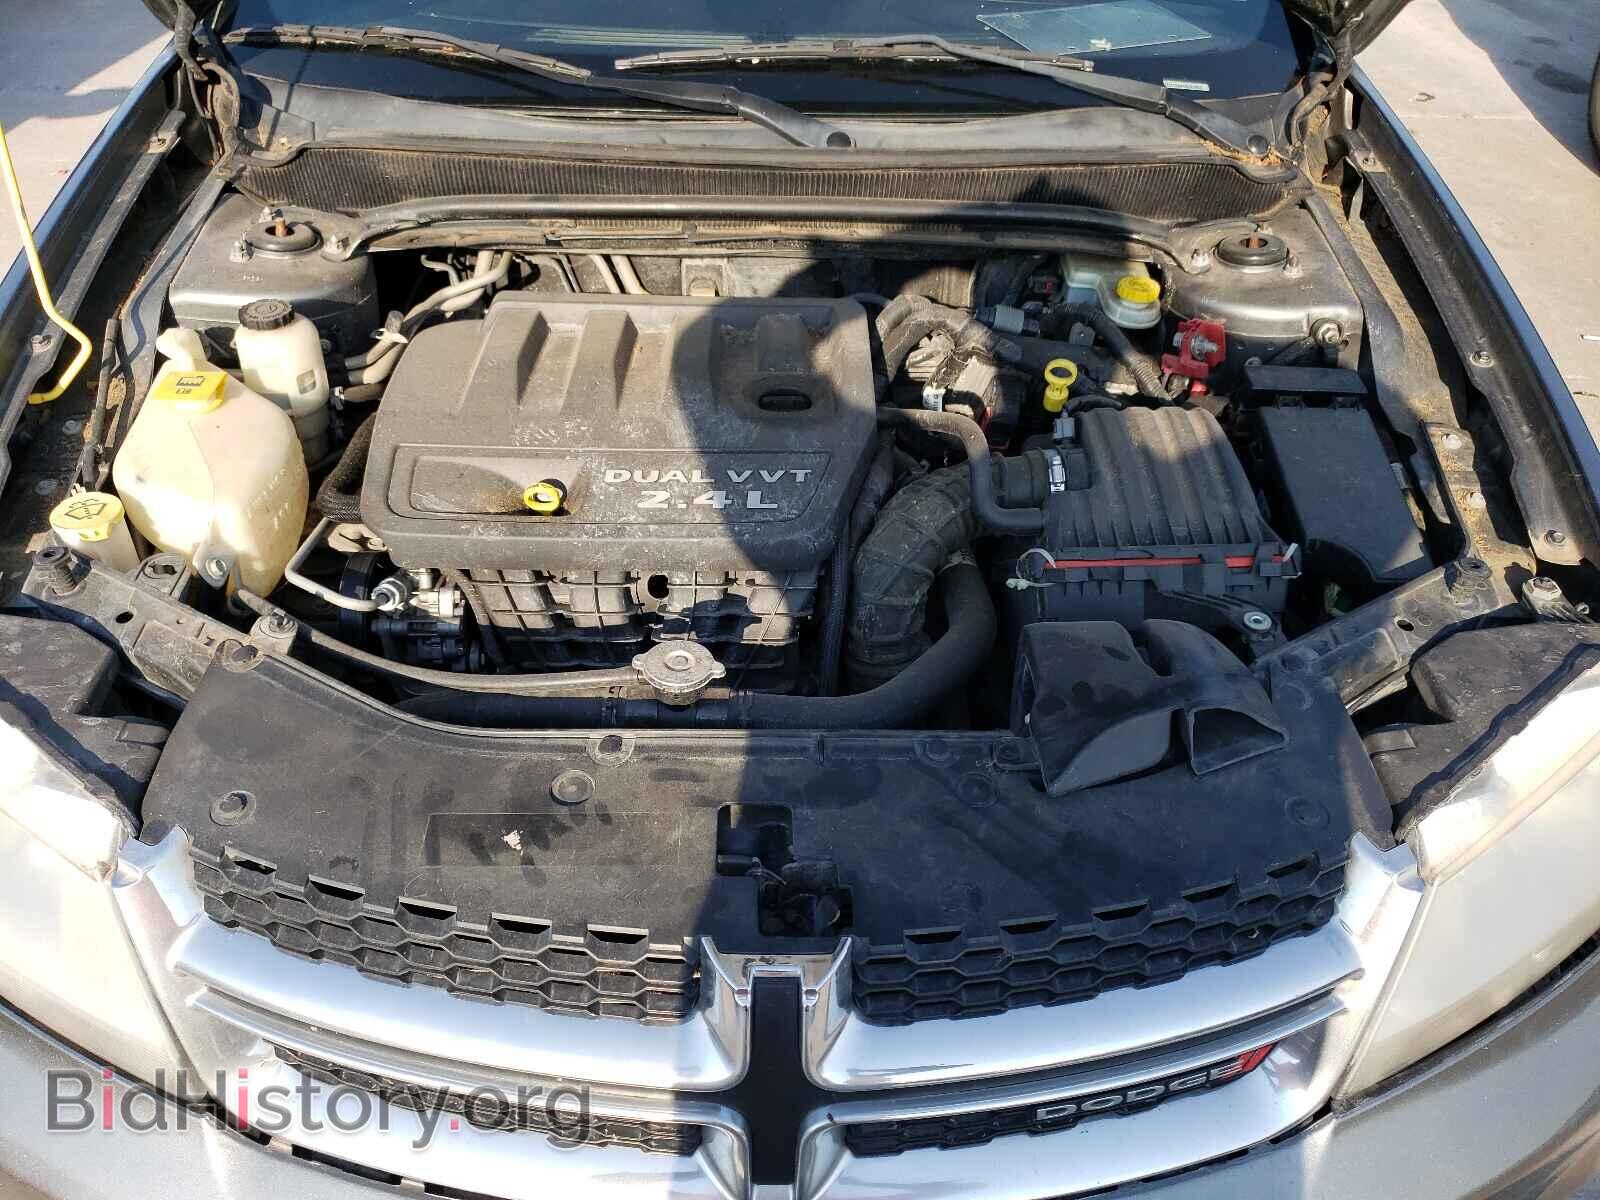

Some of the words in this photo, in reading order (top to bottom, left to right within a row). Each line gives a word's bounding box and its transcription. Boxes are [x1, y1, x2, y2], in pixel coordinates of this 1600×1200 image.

[604, 469, 715, 483] DUAL
[726, 469, 813, 483] VVT
[1036, 1057, 1245, 1121] DODGE
